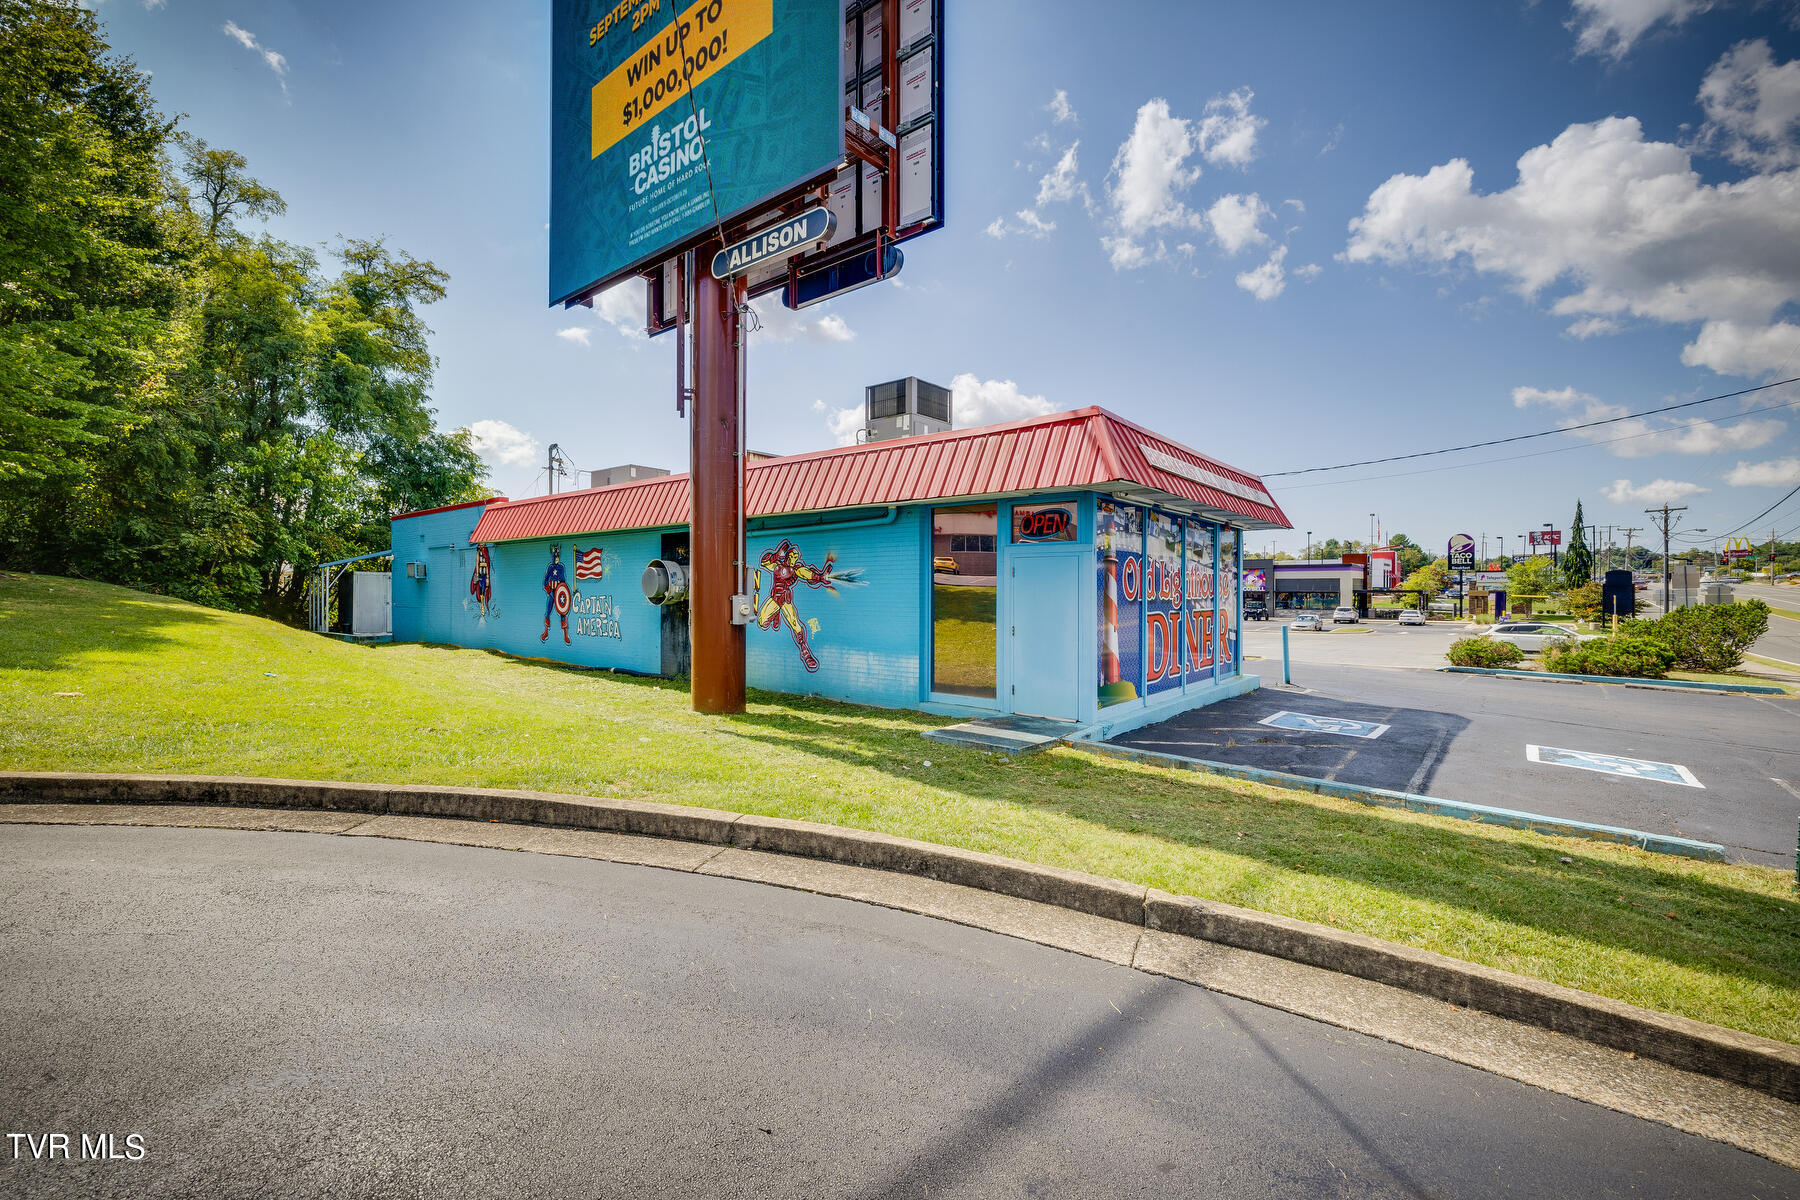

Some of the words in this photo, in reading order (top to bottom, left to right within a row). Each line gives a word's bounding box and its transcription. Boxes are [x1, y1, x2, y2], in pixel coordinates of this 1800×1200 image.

[632, 0, 660, 31] 2PM
[627, 44, 661, 87] WIN
[666, 22, 690, 57] UP
[695, 0, 723, 34] TO
[623, 29, 727, 127] $1,000,000!
[629, 108, 711, 177] BRISTOL
[634, 136, 704, 195] CASINO
[629, 195, 648, 213] FUTURE
[649, 186, 666, 200] HOME
[667, 179, 676, 190] OF
[676, 169, 693, 185] HARD
[730, 218, 808, 269] ALLISON
[1021, 513, 1067, 534] OPEN
[572, 592, 612, 617] CAPTAIN
[1123, 556, 1155, 601] Old
[1160, 560, 1230, 609] Lighthouse
[577, 617, 621, 639] AMERICA
[1147, 608, 1231, 684] DINER
